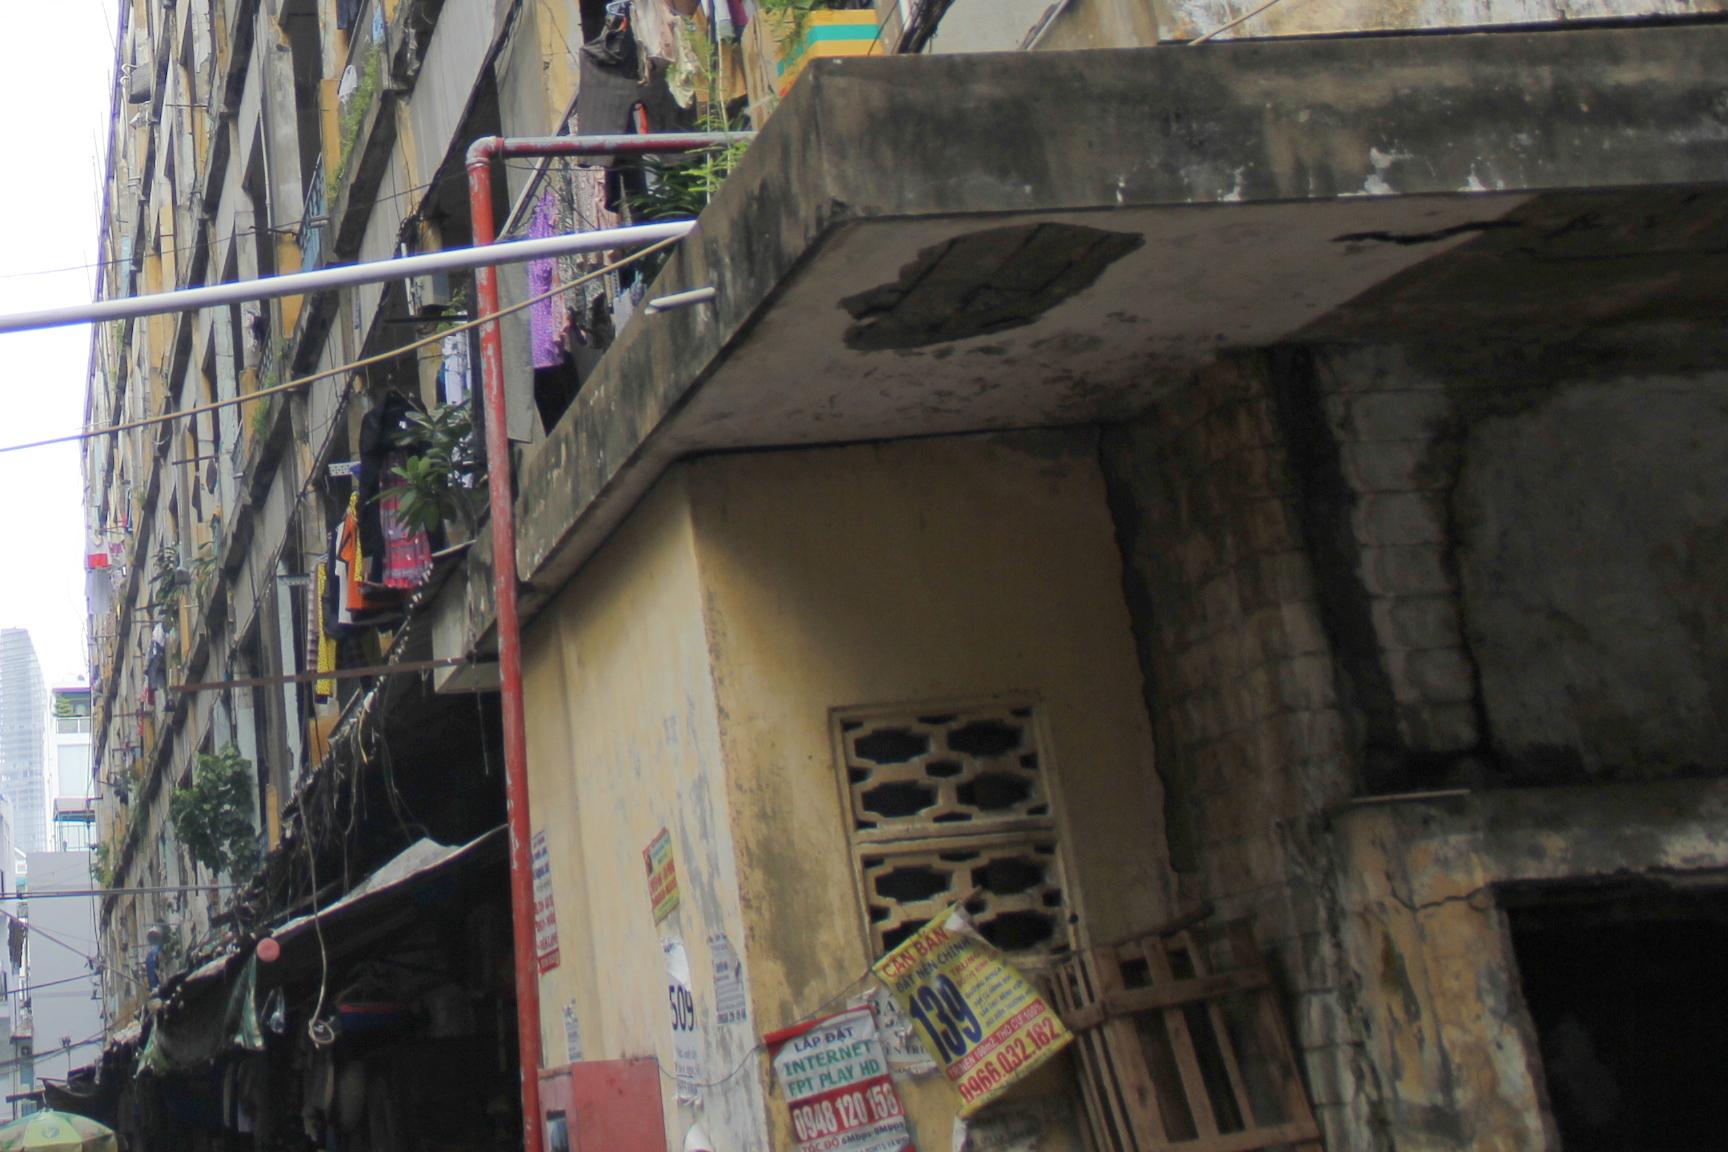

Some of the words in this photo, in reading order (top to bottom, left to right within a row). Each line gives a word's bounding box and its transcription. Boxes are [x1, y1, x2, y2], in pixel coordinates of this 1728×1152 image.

[668, 984, 694, 1031] 509
[909, 973, 982, 1064] 139
[783, 1039, 873, 1077] INTERNET
[788, 1077, 814, 1097] FPT
[819, 1065, 854, 1089] PLAY
[859, 1059, 881, 1076] HD
[957, 1016, 1061, 1103] 0966.032.182
[793, 1100, 838, 1140] 0948
[835, 1091, 869, 1128] 120
[865, 1082, 899, 1120] 158
